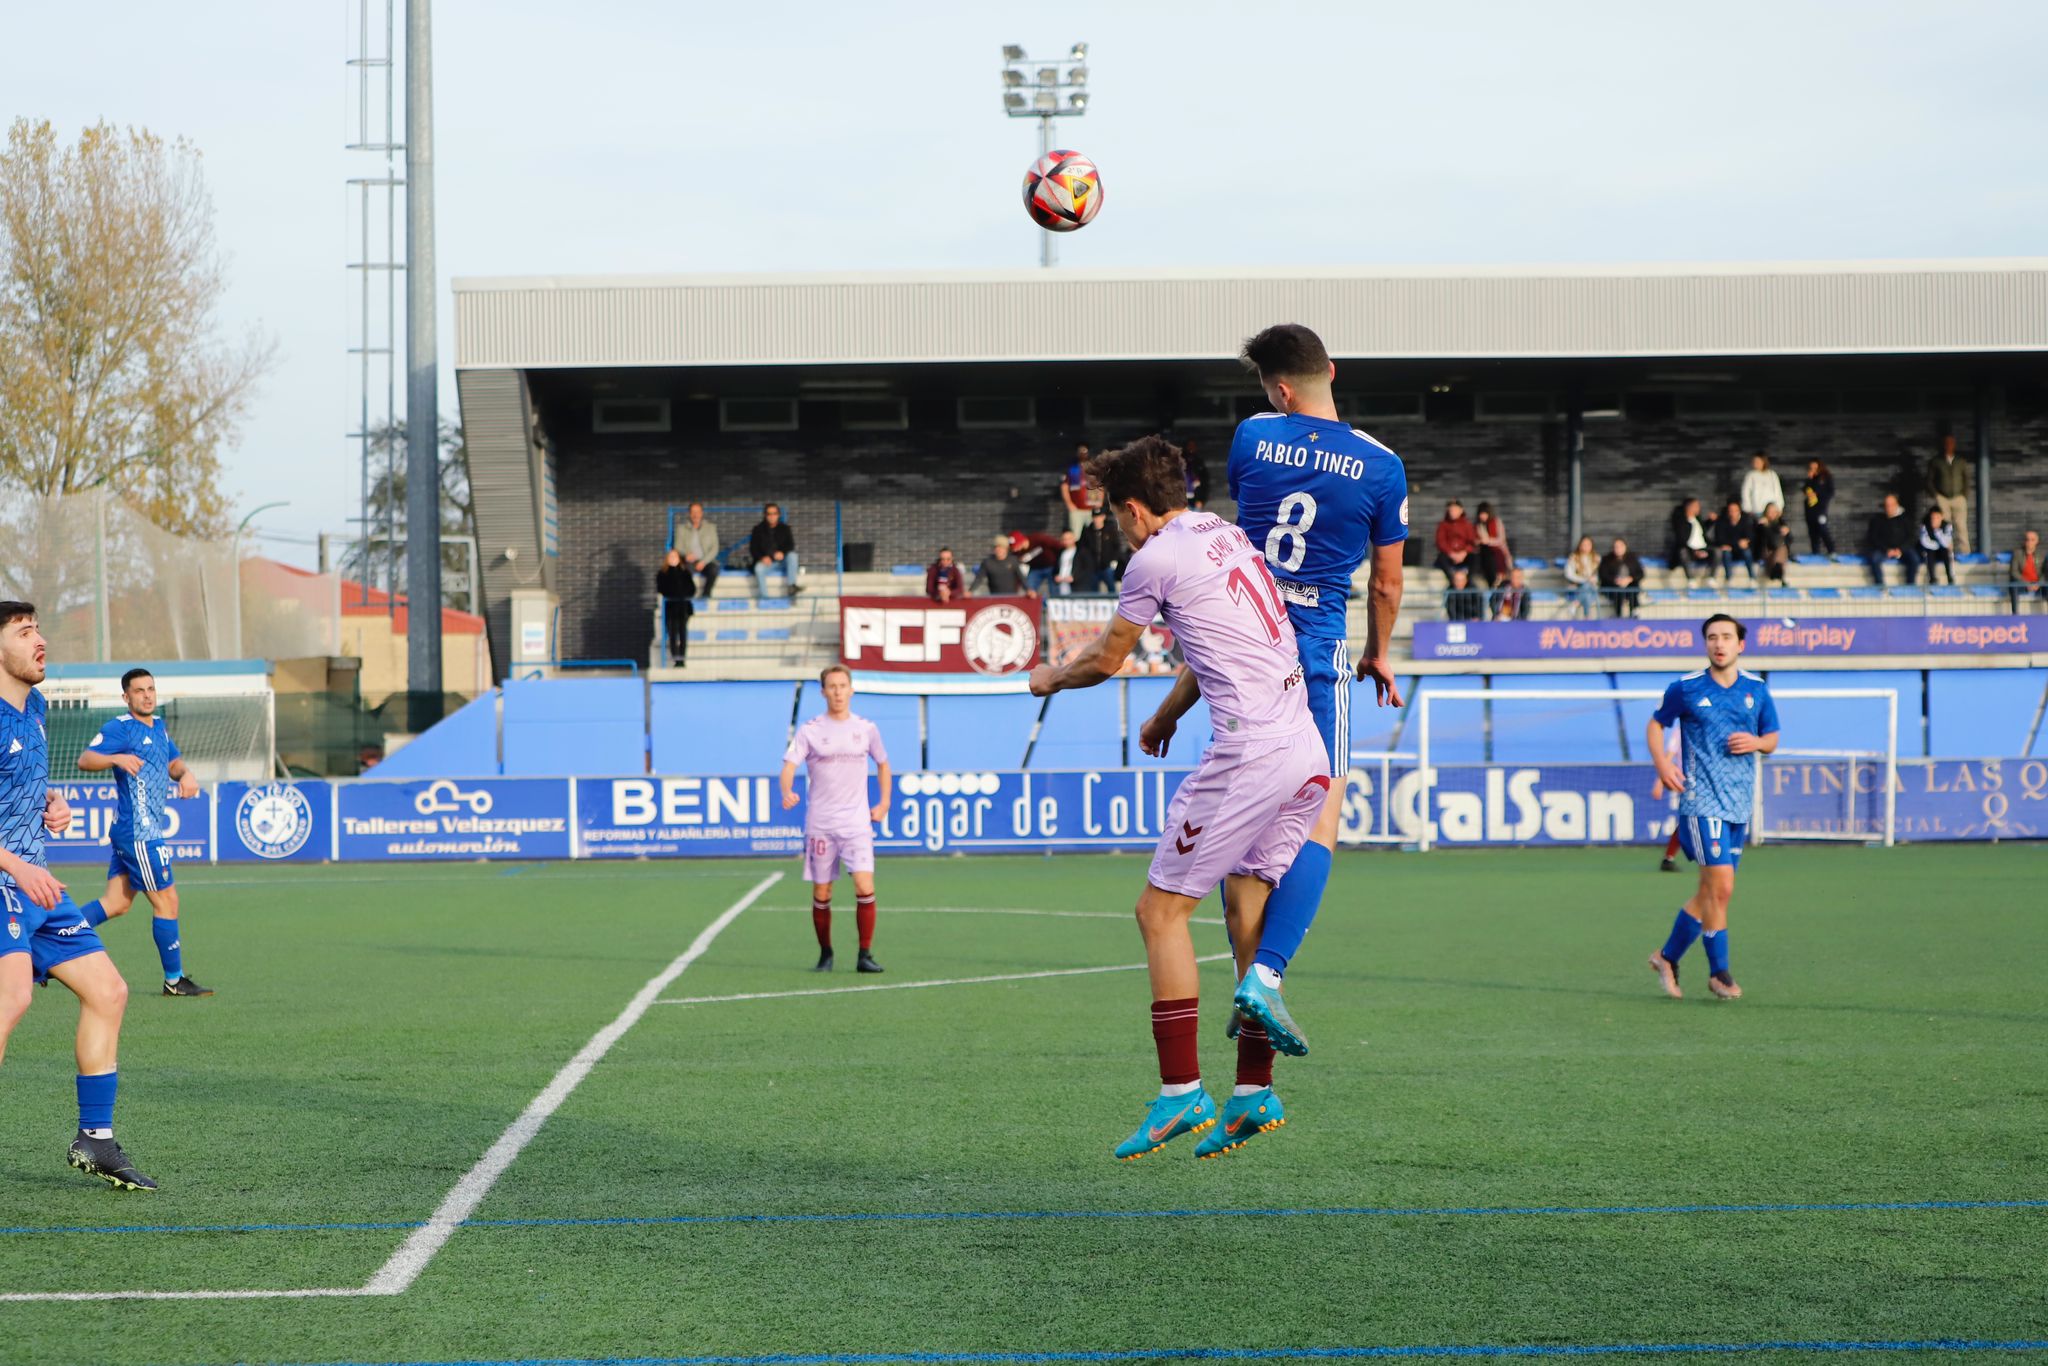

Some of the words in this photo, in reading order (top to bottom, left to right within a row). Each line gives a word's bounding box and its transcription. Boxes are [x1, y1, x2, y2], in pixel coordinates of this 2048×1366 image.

[1256, 440, 1307, 468] PABLO
[1314, 450, 1364, 480] TINEO
[1265, 491, 1317, 573] 8
[844, 607, 966, 662] PCF
[1540, 626, 1693, 650] #VamosCova
[1757, 624, 1856, 650] #fairplay
[1928, 622, 2029, 649] #respect
[1434, 644, 1482, 656] OVIEDO
[1772, 765, 1907, 796] FINCA
[1925, 762, 2003, 793] LAS
[612, 777, 771, 826] BENI
[1013, 771, 1058, 837] de
[1083, 771, 1166, 836] Coll
[1391, 768, 1635, 841] CalSan
[343, 817, 438, 835] Talleres
[441, 816, 566, 836] Velazquez
[583, 829, 646, 842] REFORMAS
[648, 829, 656, 841] Y
[733, 827, 749, 839] EN
[751, 825, 805, 838] GENERAL
[155, 845, 170, 866] 19
[388, 836, 520, 854] automoción
